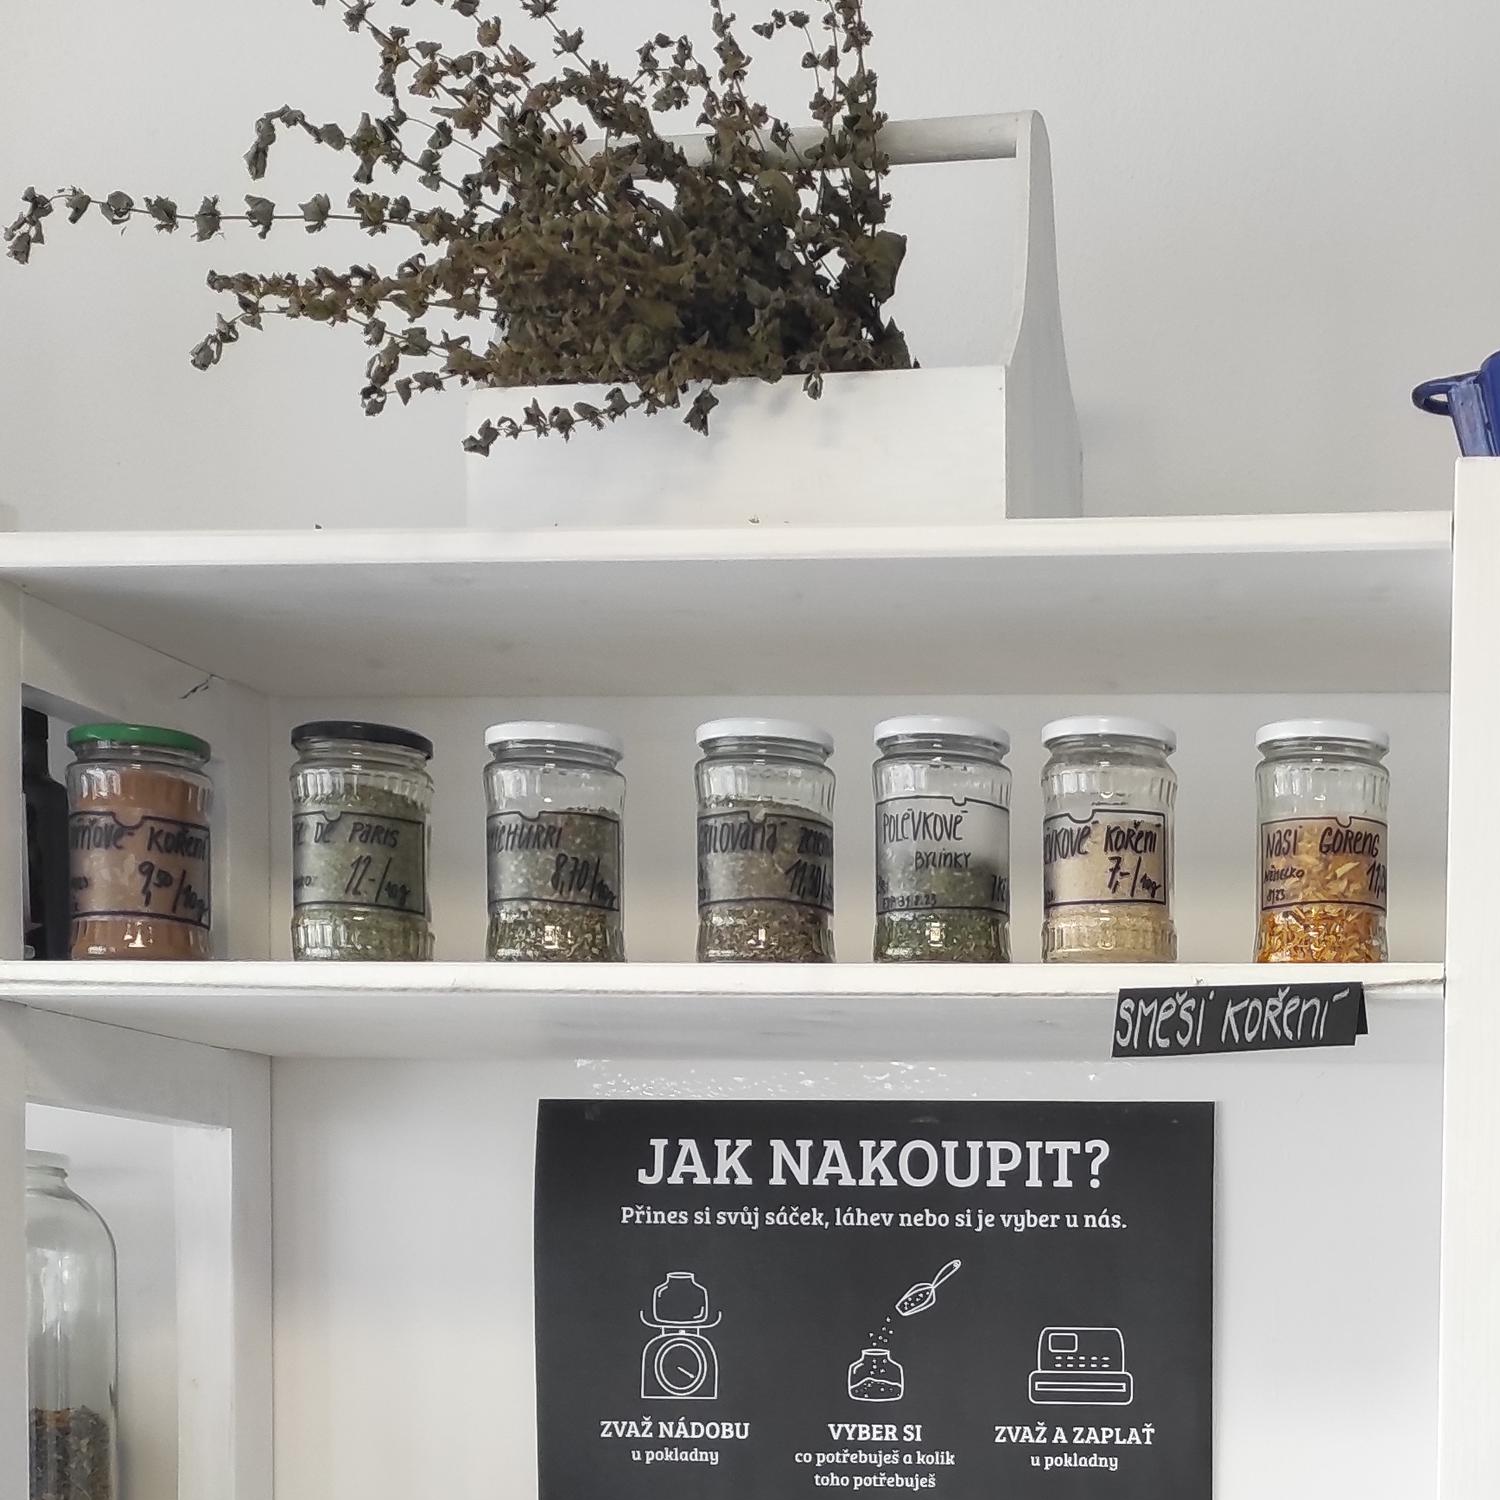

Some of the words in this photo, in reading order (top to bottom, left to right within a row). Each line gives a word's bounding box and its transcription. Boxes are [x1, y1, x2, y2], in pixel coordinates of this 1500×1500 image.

[348, 821, 400, 848] PARIS
[883, 808, 968, 843] POLÉVKOVÉ
[1104, 820, 1161, 854] KOŘENÍ
[1266, 825, 1303, 858] NASI
[1319, 827, 1380, 858] GORENG
[1115, 988, 1207, 1051] SMĚSI
[1221, 986, 1353, 1044] KOŘENÍ
[637, 1138, 753, 1185] JAK
[768, 1139, 1110, 1189] NAKOUPIT?
[620, 1204, 689, 1225] Přines
[693, 1206, 712, 1225] si
[716, 1206, 759, 1230] svůj
[765, 1205, 830, 1229] sáček,
[835, 1206, 895, 1227] láhev
[898, 1208, 950, 1228] nebo
[955, 1208, 973, 1227] si
[974, 1209, 995, 1232] je
[999, 1209, 1061, 1233] vyber
[1064, 1214, 1079, 1228] u
[1083, 1207, 1127, 1229] nás.
[600, 1415, 654, 1438] ZVAŽ
[658, 1416, 750, 1440] NÁDOBU
[827, 1423, 899, 1442] VYBER
[902, 1424, 923, 1442] SI
[994, 1421, 1048, 1444] ZVAŽ
[1051, 1426, 1069, 1444] A
[1072, 1422, 1156, 1445] ZAPLAŤ
[631, 1450, 642, 1461] u
[644, 1446, 719, 1466] pokladny
[794, 1452, 811, 1464] co
[814, 1448, 900, 1468] potřebuješ
[902, 1453, 913, 1465] a
[915, 1450, 956, 1466] kolik
[1030, 1455, 1041, 1467] u
[1043, 1452, 1119, 1472] pokladny
[813, 1472, 850, 1487] toho
[852, 1472, 936, 1492] potřebuješ
